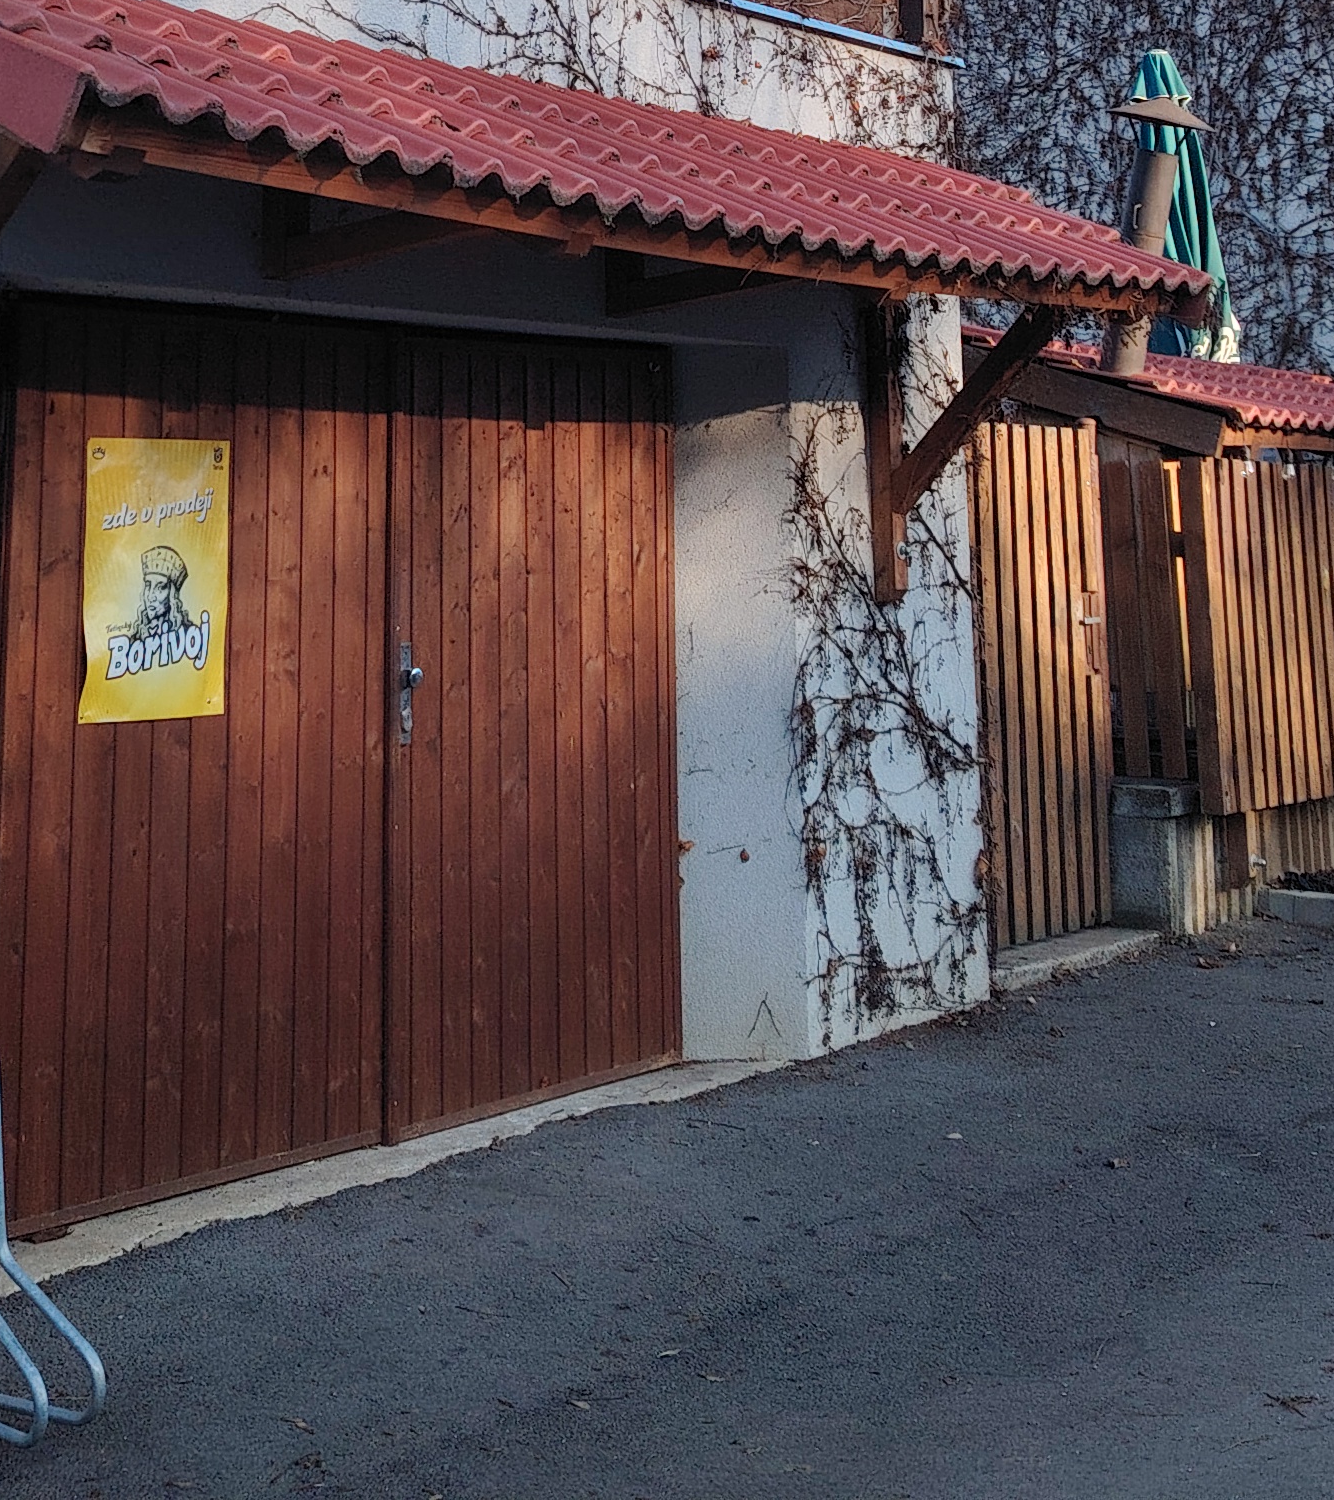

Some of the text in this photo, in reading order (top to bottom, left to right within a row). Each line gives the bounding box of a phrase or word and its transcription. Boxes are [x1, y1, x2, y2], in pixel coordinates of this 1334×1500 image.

[101, 488, 214, 531] zde v prodeji
[105, 610, 211, 681] Bořivoj
